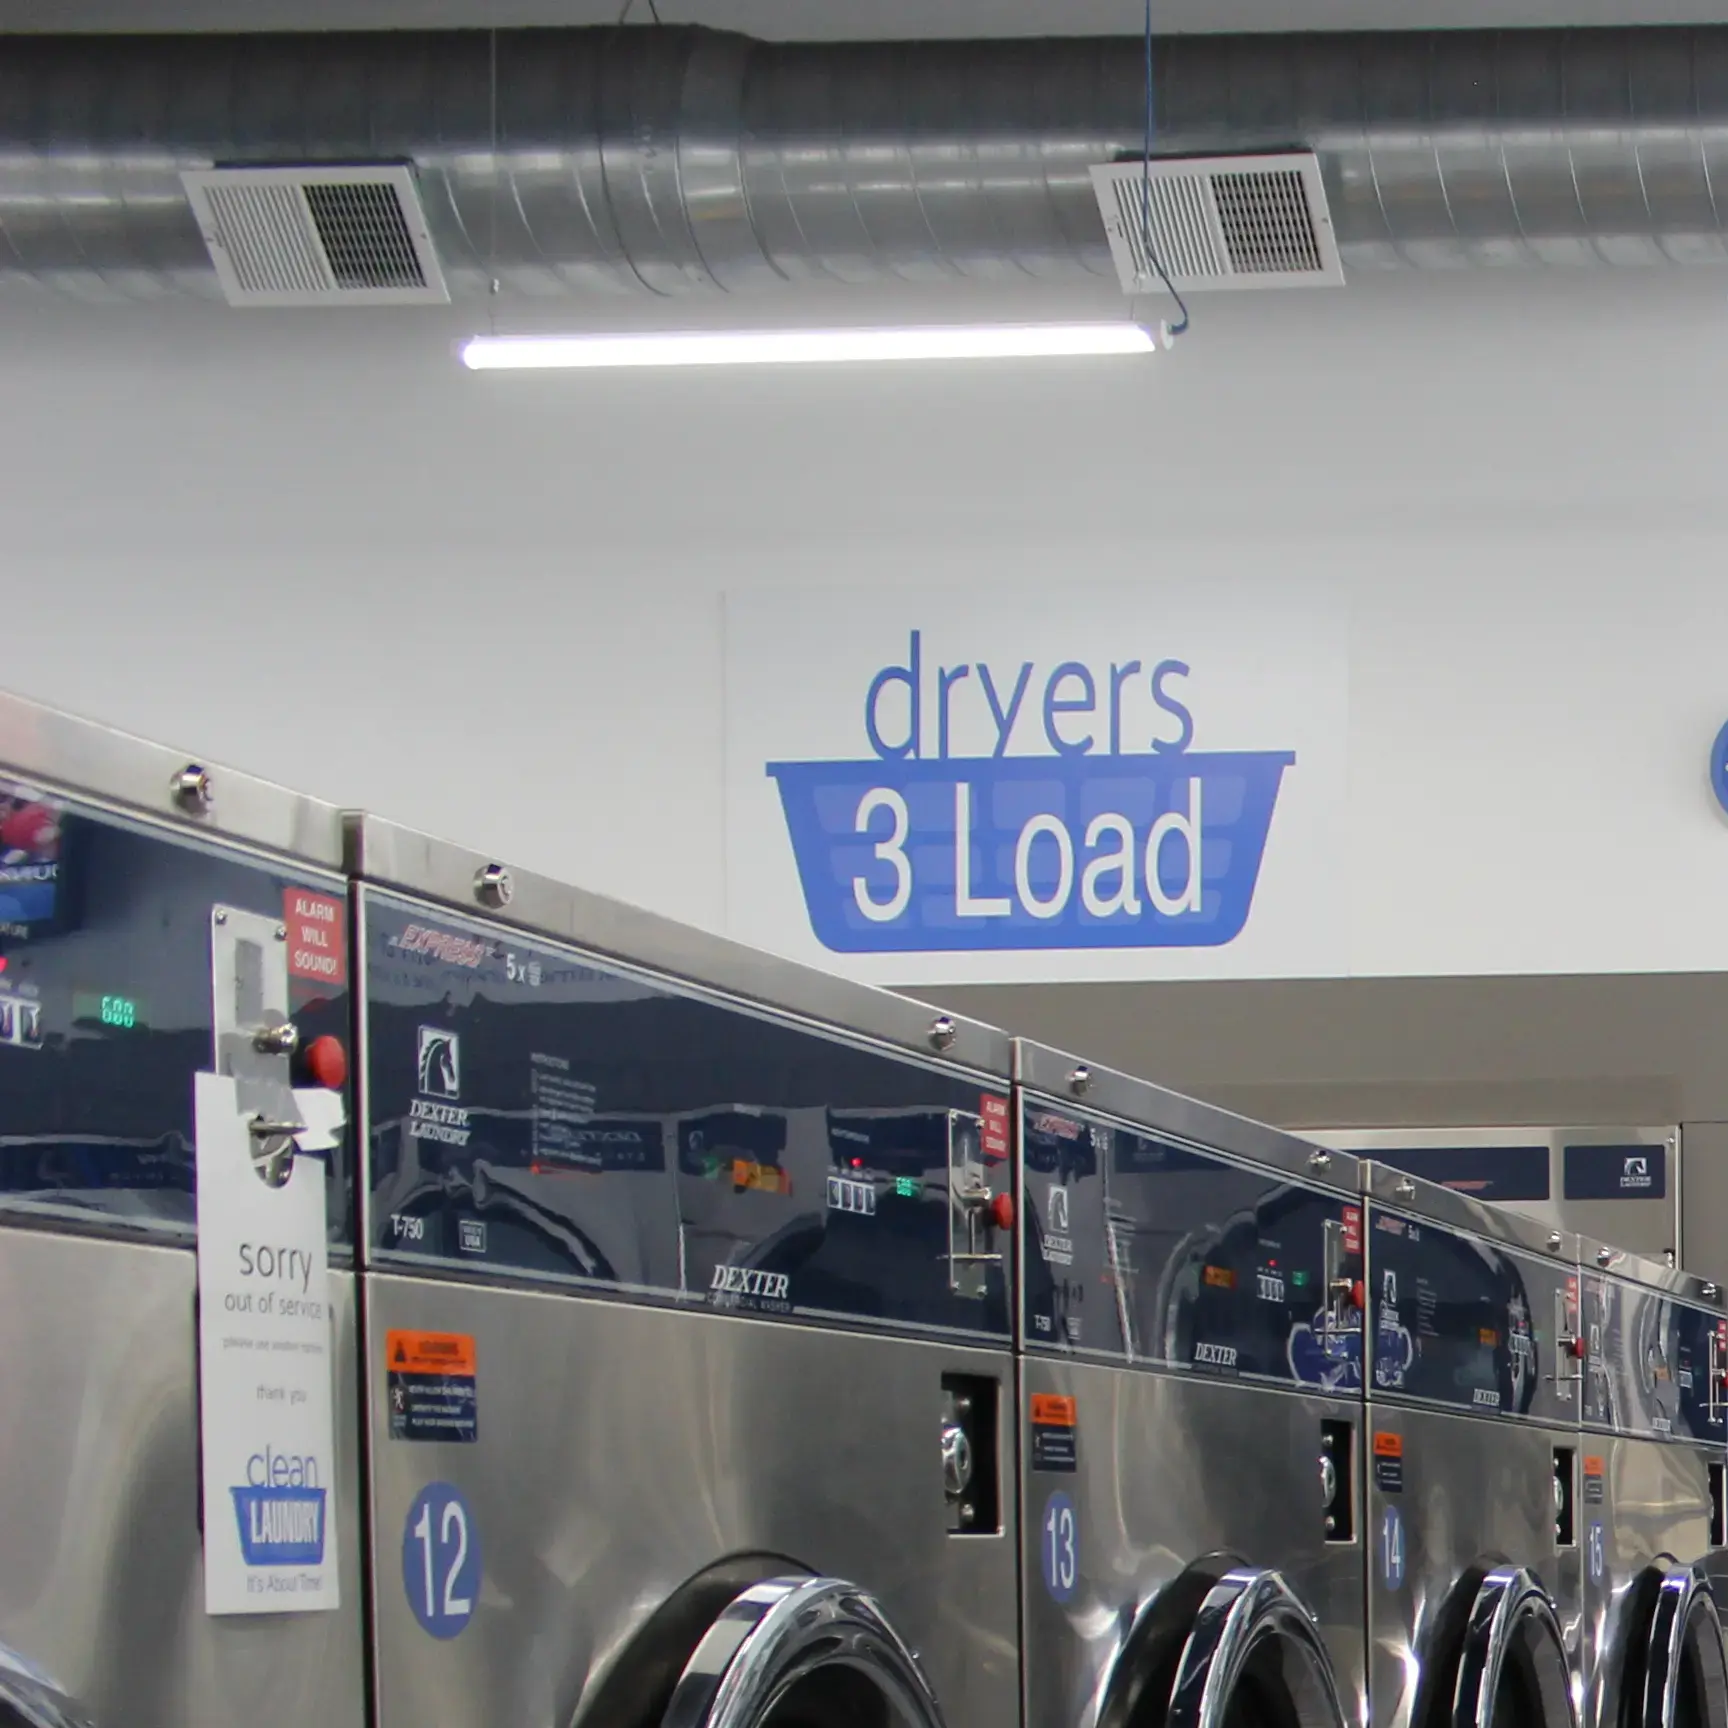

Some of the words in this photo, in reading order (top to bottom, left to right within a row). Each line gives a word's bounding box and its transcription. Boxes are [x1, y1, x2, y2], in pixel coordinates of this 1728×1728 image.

[865, 630, 1194, 758] dryers
[852, 786, 911, 922] 3
[956, 774, 1202, 918] Load
[295, 899, 336, 923] ALARM
[301, 925, 329, 948] WILL
[294, 950, 338, 976] SOUND!
[505, 952, 517, 980] 5
[410, 1099, 470, 1128] DEXTER
[391, 1213, 424, 1240] T-750
[239, 1242, 312, 1294] sorry
[710, 1264, 789, 1300] DEXTER
[224, 1292, 252, 1314] out
[259, 1291, 275, 1314] of
[279, 1299, 322, 1320] service
[1194, 1342, 1237, 1366] DEXTER
[246, 1444, 318, 1488] clean
[250, 1500, 319, 1544] LAUNDRY
[415, 1500, 471, 1618] 12
[1046, 1506, 1074, 1589] 13
[1383, 1514, 1401, 1579] 14
[1590, 1525, 1602, 1577] 15
